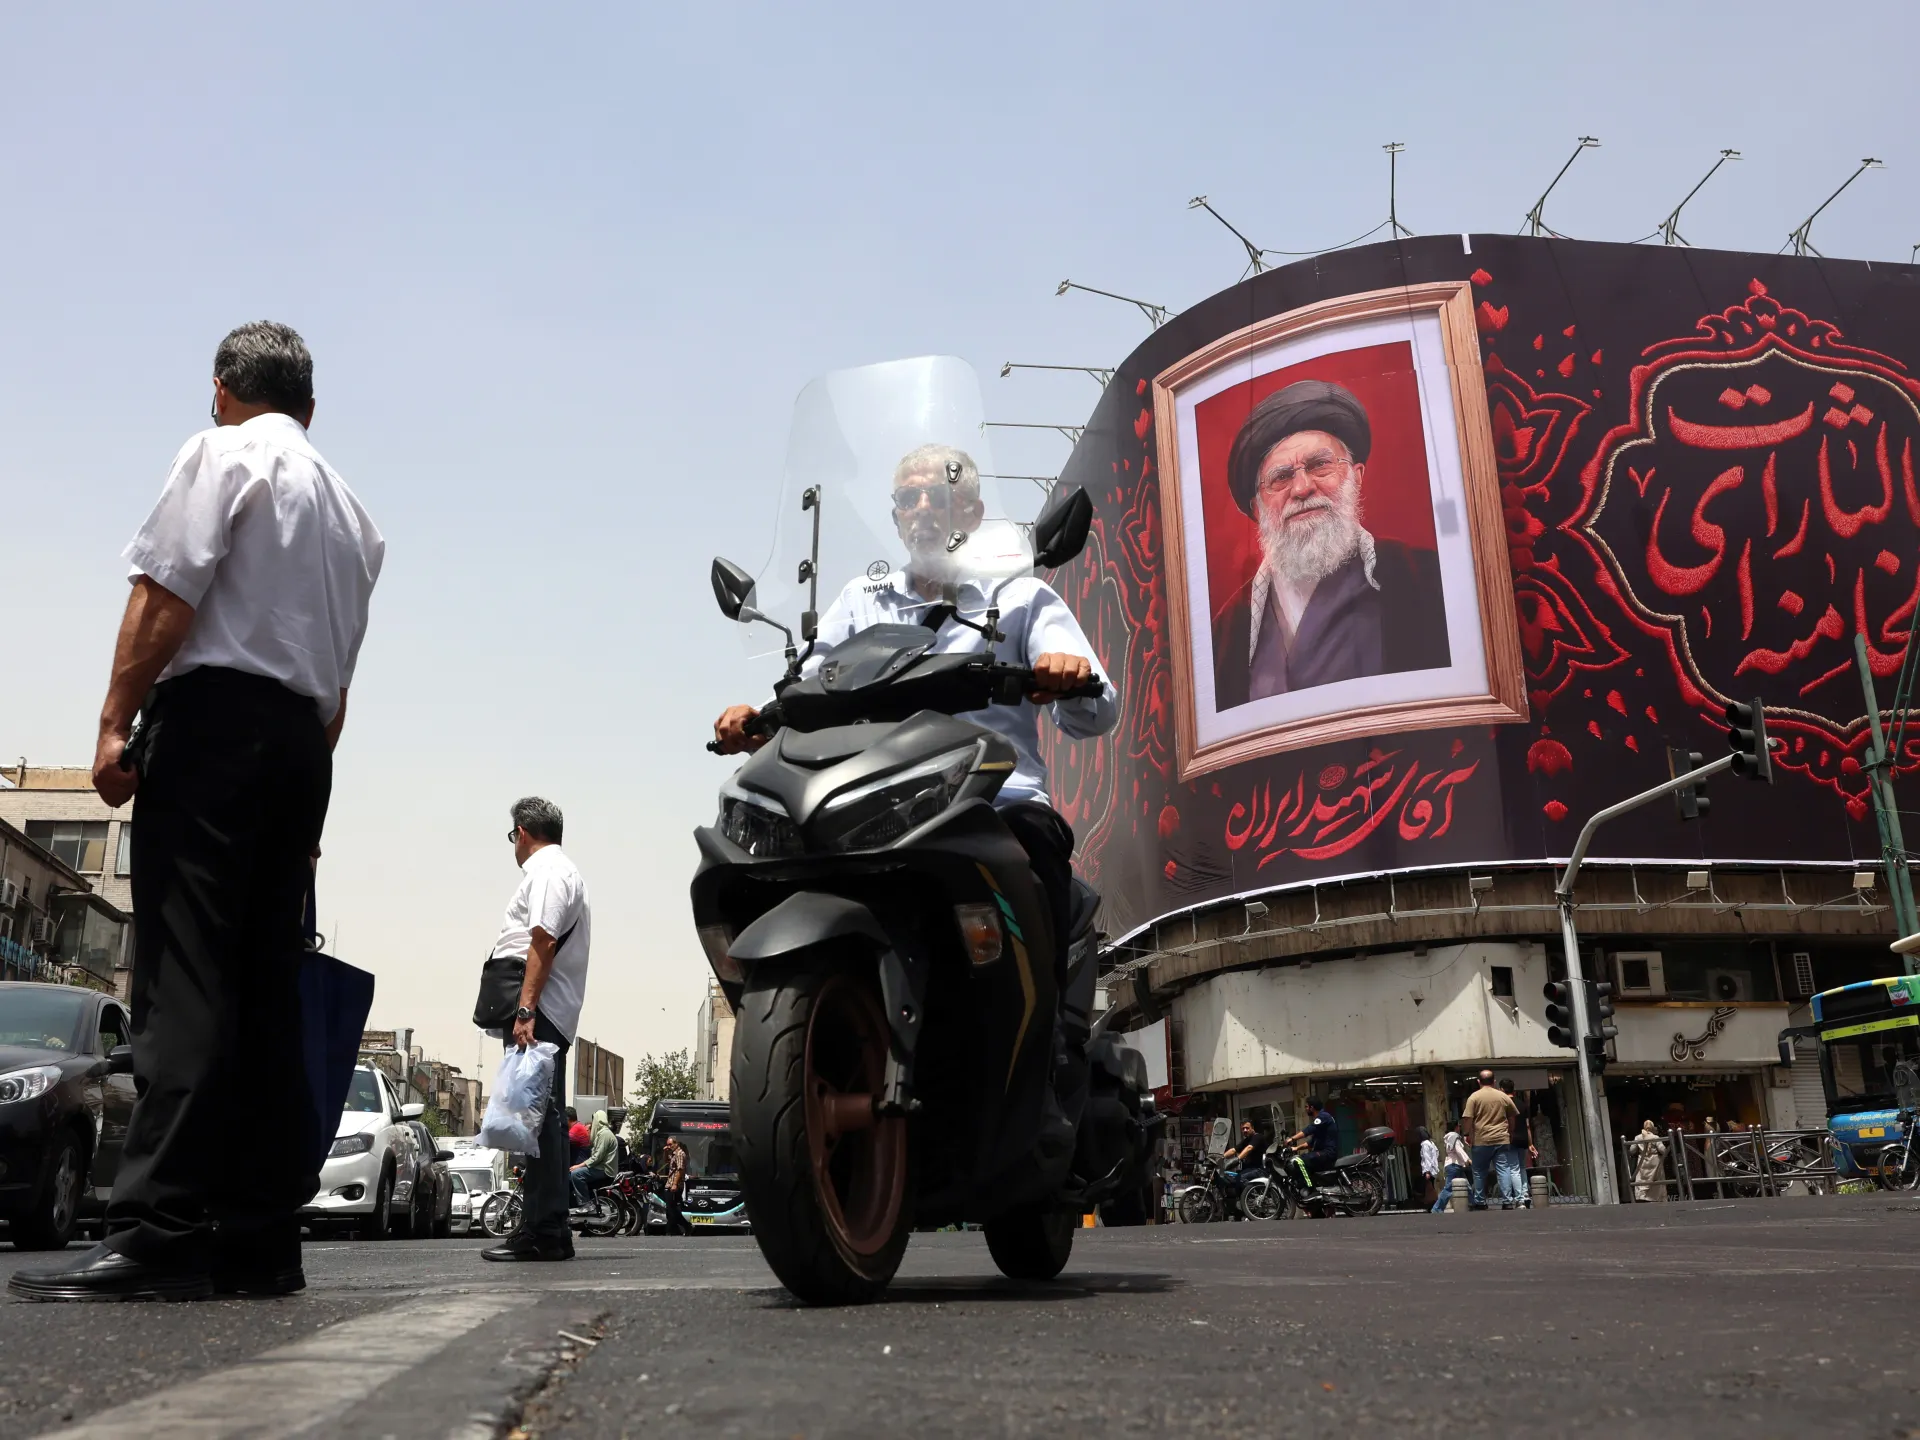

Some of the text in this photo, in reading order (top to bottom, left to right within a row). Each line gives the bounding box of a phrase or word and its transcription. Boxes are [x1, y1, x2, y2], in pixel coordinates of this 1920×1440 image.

[863, 582, 895, 594] YAMAHA
[1225, 749, 1480, 871] آقای شهید ایران
[1671, 1007, 1738, 1062] نگین
